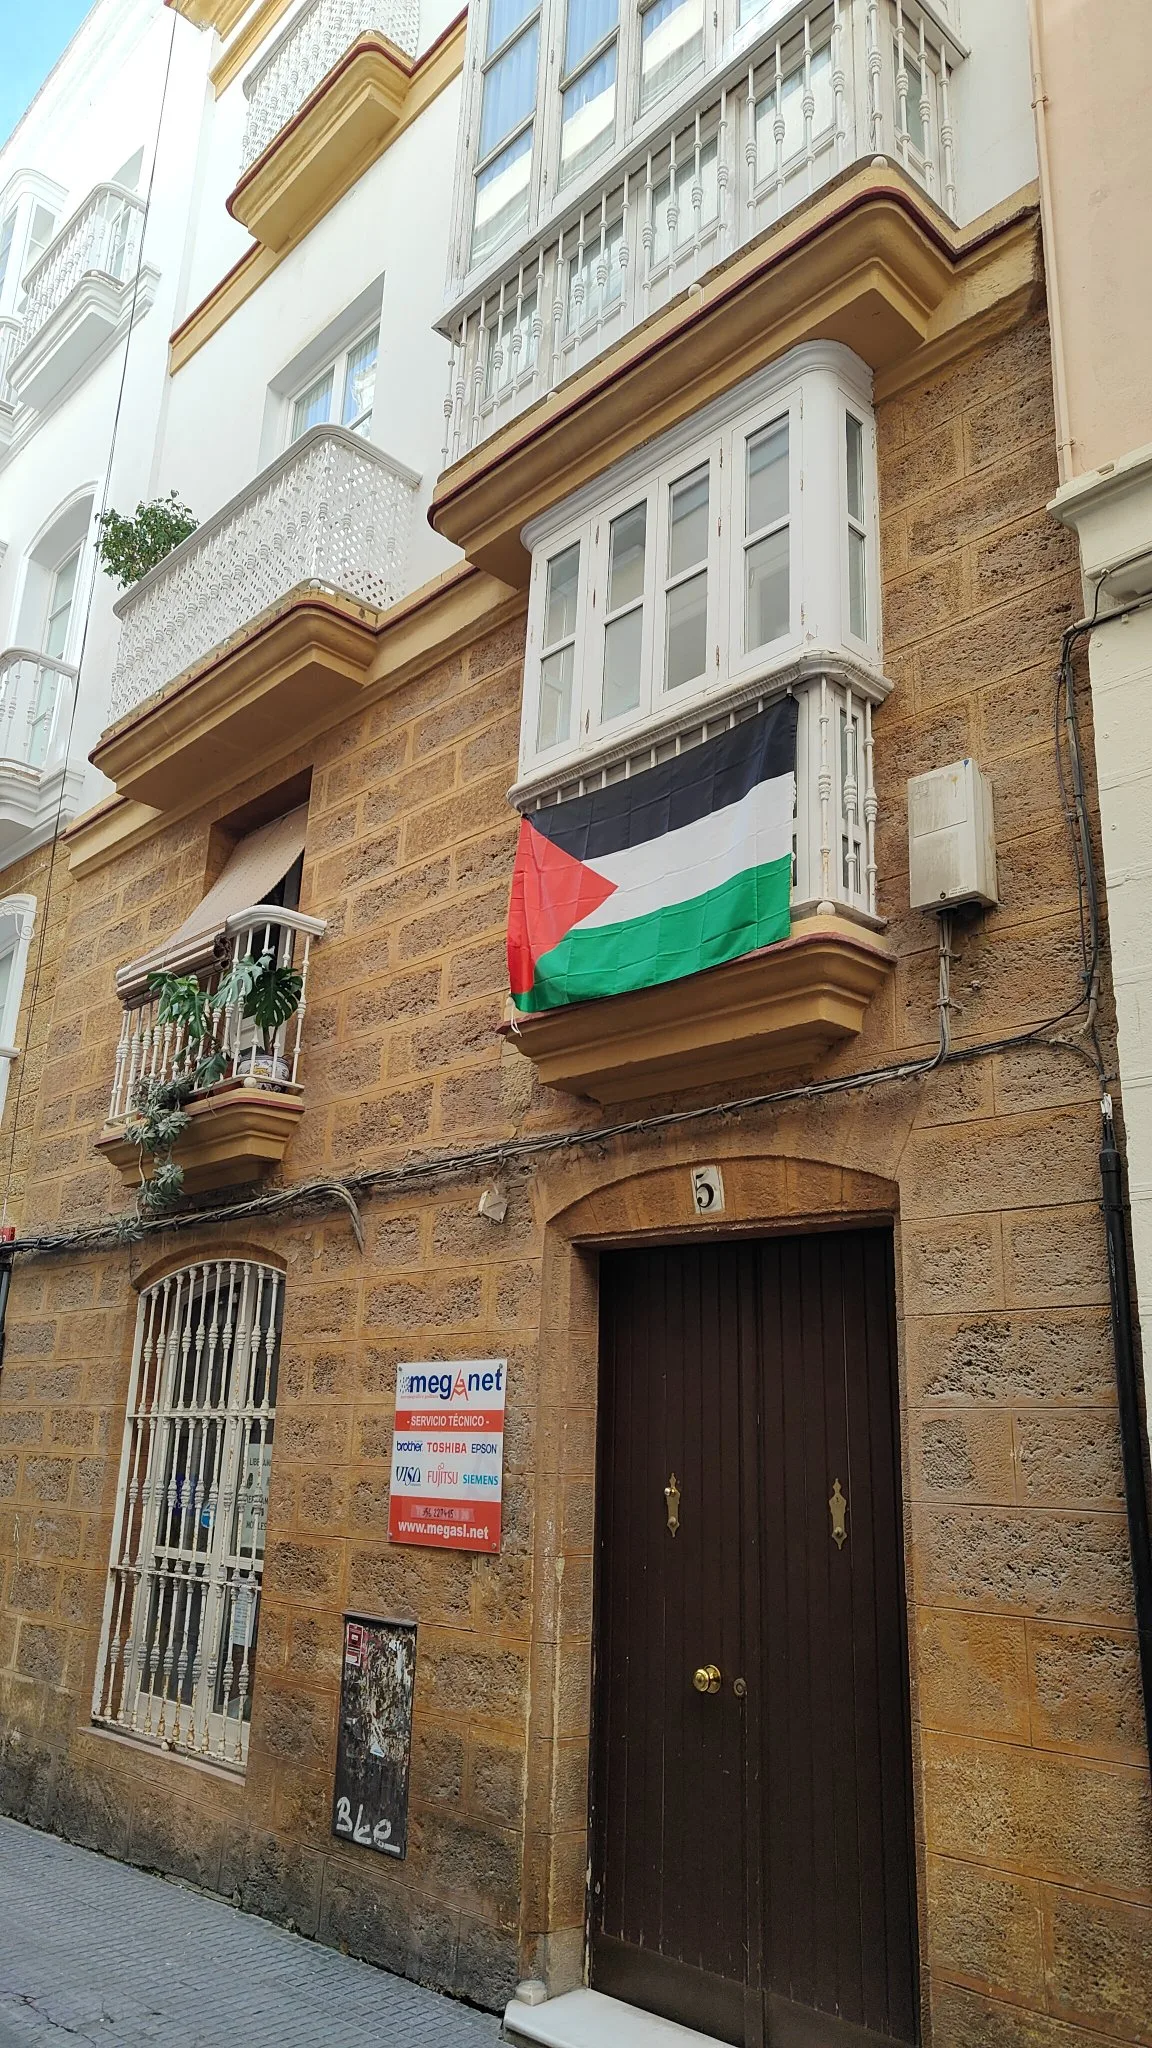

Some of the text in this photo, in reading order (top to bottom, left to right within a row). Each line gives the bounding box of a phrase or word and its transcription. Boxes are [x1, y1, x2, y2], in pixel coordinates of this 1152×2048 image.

[695, 1171, 714, 1209] 5
[410, 1415, 447, 1427] SERVICIO
[448, 1413, 485, 1427] TÉCNICO
[396, 1440, 498, 1454] brother TOSHIBA EPSON
[395, 1464, 499, 1487] VISA FUJITSU SIEMENS
[398, 1521, 489, 1540] www.megasl.net
